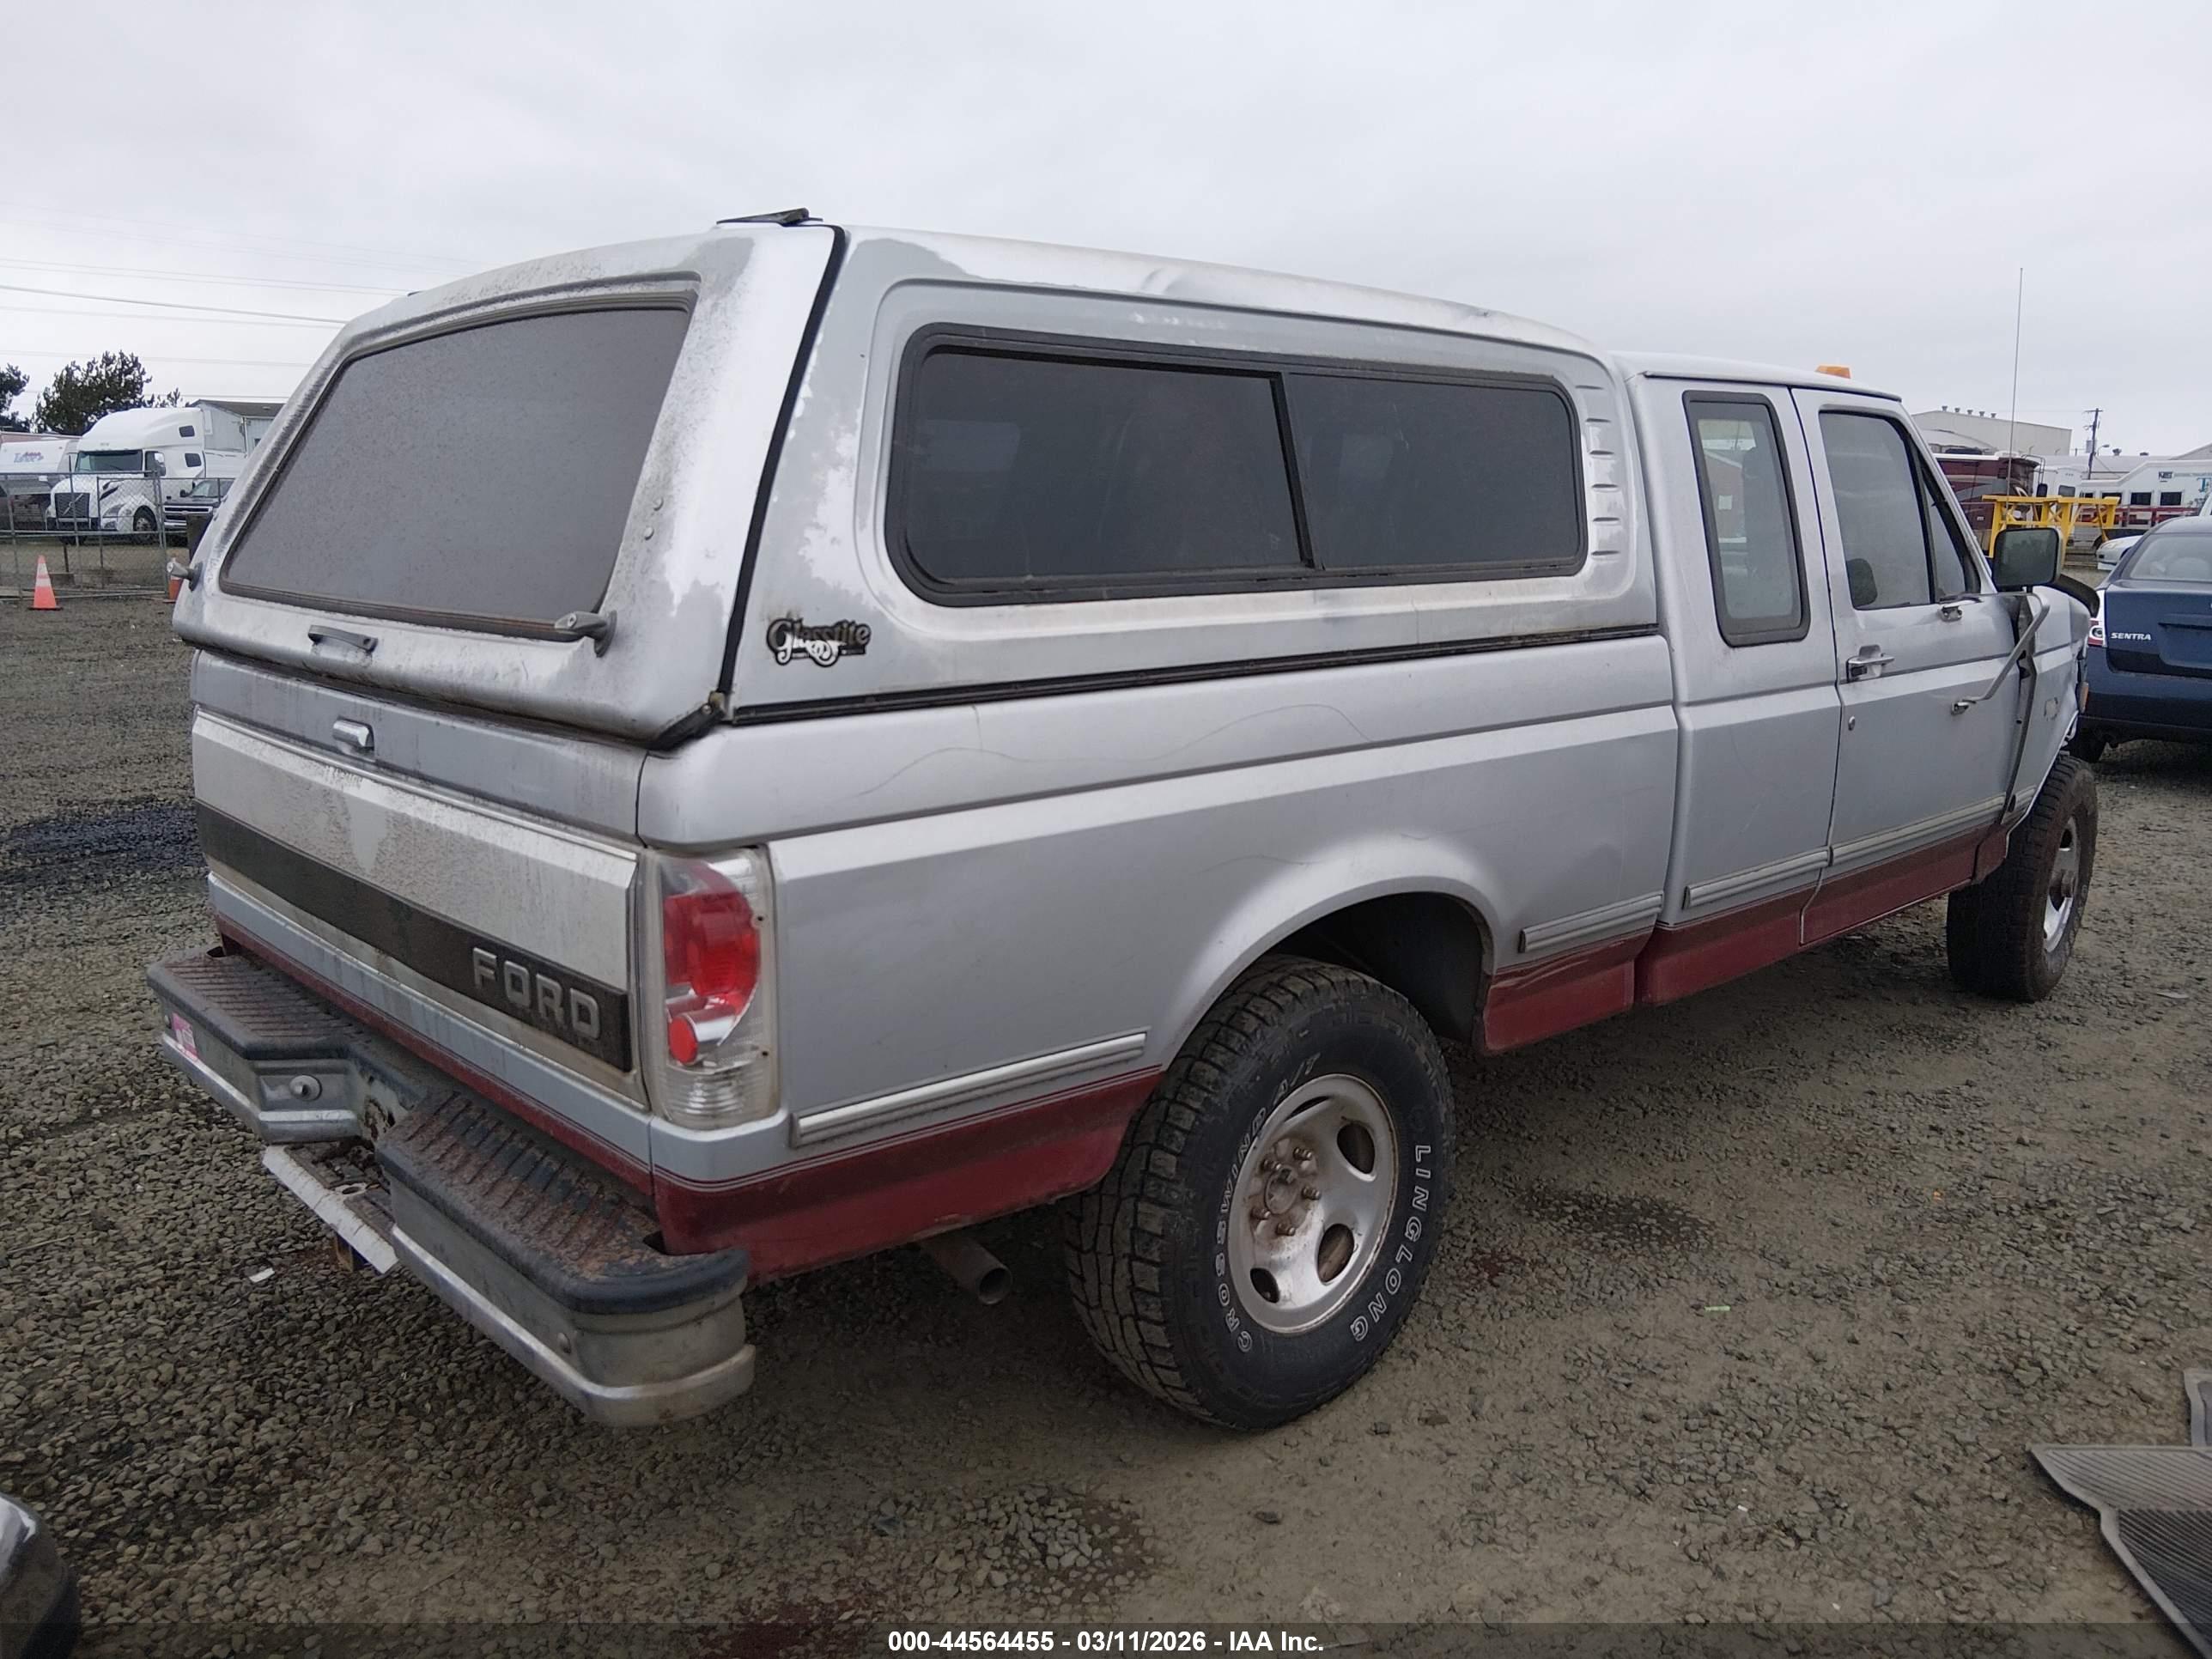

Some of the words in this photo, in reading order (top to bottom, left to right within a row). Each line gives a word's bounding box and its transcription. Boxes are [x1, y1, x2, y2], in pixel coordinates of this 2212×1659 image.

[2110, 631, 2152, 641] SENTRA
[471, 946, 601, 1040] FORD
[1349, 1144, 1431, 1342] LINGLONG
